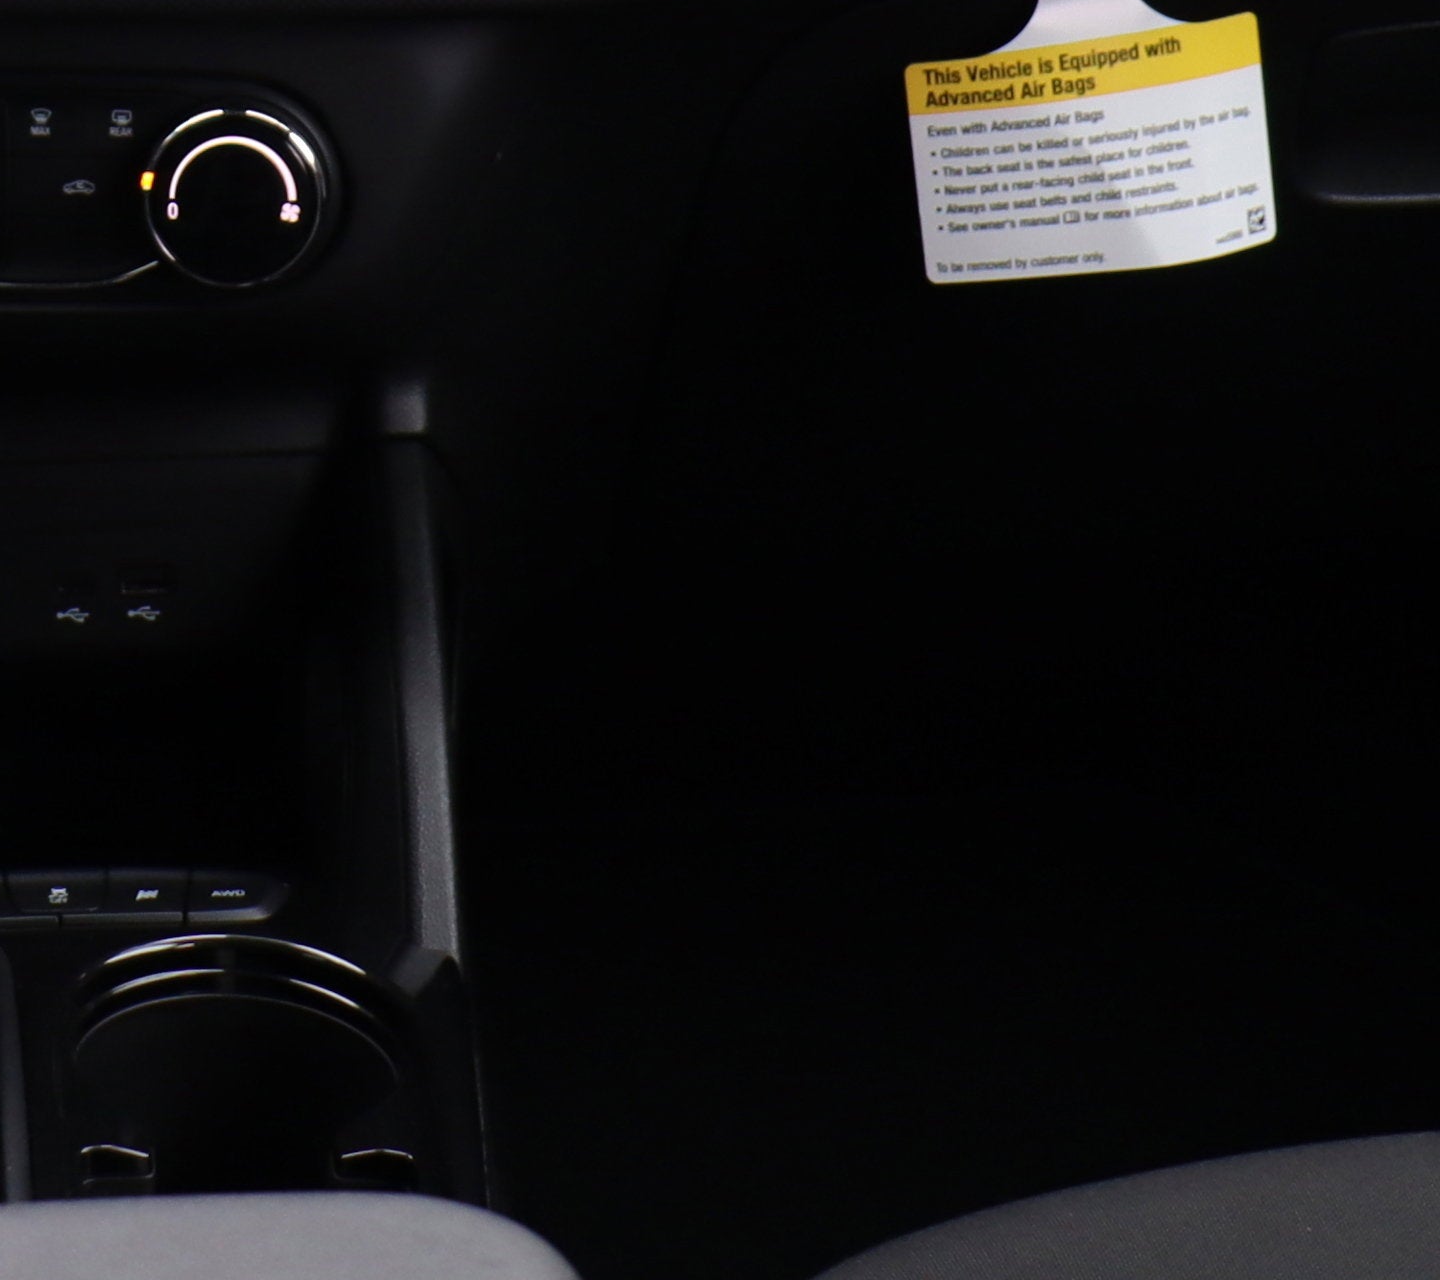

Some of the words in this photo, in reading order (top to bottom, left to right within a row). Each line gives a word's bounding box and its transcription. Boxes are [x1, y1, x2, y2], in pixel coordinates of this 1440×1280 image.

[924, 68, 961, 86] This
[967, 61, 1032, 82] Vehicle
[1039, 57, 1054, 75] is
[1059, 44, 1140, 72] Equipped
[1145, 37, 1181, 58] with
[926, 85, 1015, 108] Advanced
[1021, 82, 1045, 99] Air
[1052, 77, 1096, 95] Bags
[927, 125, 958, 138] Even
[961, 120, 987, 135] with
[991, 116, 1051, 133] Advanced
[1054, 114, 1071, 126] Air
[1075, 110, 1105, 125] Bags
[940, 144, 989, 159] Children
[993, 143, 1014, 155] can
[1018, 140, 1033, 152] be
[1036, 136, 1069, 150] killed
[1072, 136, 1085, 146] or
[1088, 128, 1139, 145] seriously
[1142, 120, 1180, 138] injured
[1183, 118, 1196, 131] by
[1199, 114, 1215, 126] the
[943, 165, 963, 177] The
[966, 163, 993, 175] back
[996, 161, 1020, 173] seat
[1024, 159, 1033, 171] is
[1037, 158, 1055, 169] the
[1095, 149, 1125, 166] place
[1127, 146, 1143, 158] for
[944, 184, 976, 196] Never
[980, 182, 998, 195] put
[1002, 183, 1009, 192] a
[1011, 175, 1075, 191] rear-facing
[1078, 171, 1105, 184] child
[1107, 168, 1131, 182] seat
[1134, 166, 1145, 177] in
[1147, 162, 1165, 174] the
[166, 202, 179, 221] 0
[946, 202, 986, 216] Always
[989, 200, 1009, 212] use
[1012, 197, 1037, 210] seat
[1040, 194, 1067, 207] belts
[1071, 191, 1092, 204] and
[1095, 189, 1122, 202] child
[948, 221, 968, 233] See
[972, 218, 1016, 231] owner's
[1019, 214, 1060, 227] manual
[1085, 210, 1100, 222] for
[1103, 209, 1131, 220] more
[1134, 198, 1194, 217] information
[1197, 191, 1222, 206] about
[936, 261, 948, 274] To
[951, 261, 964, 273] be
[967, 258, 1012, 271] removed
[1015, 257, 1028, 270] by
[1030, 254, 1079, 267] customer
